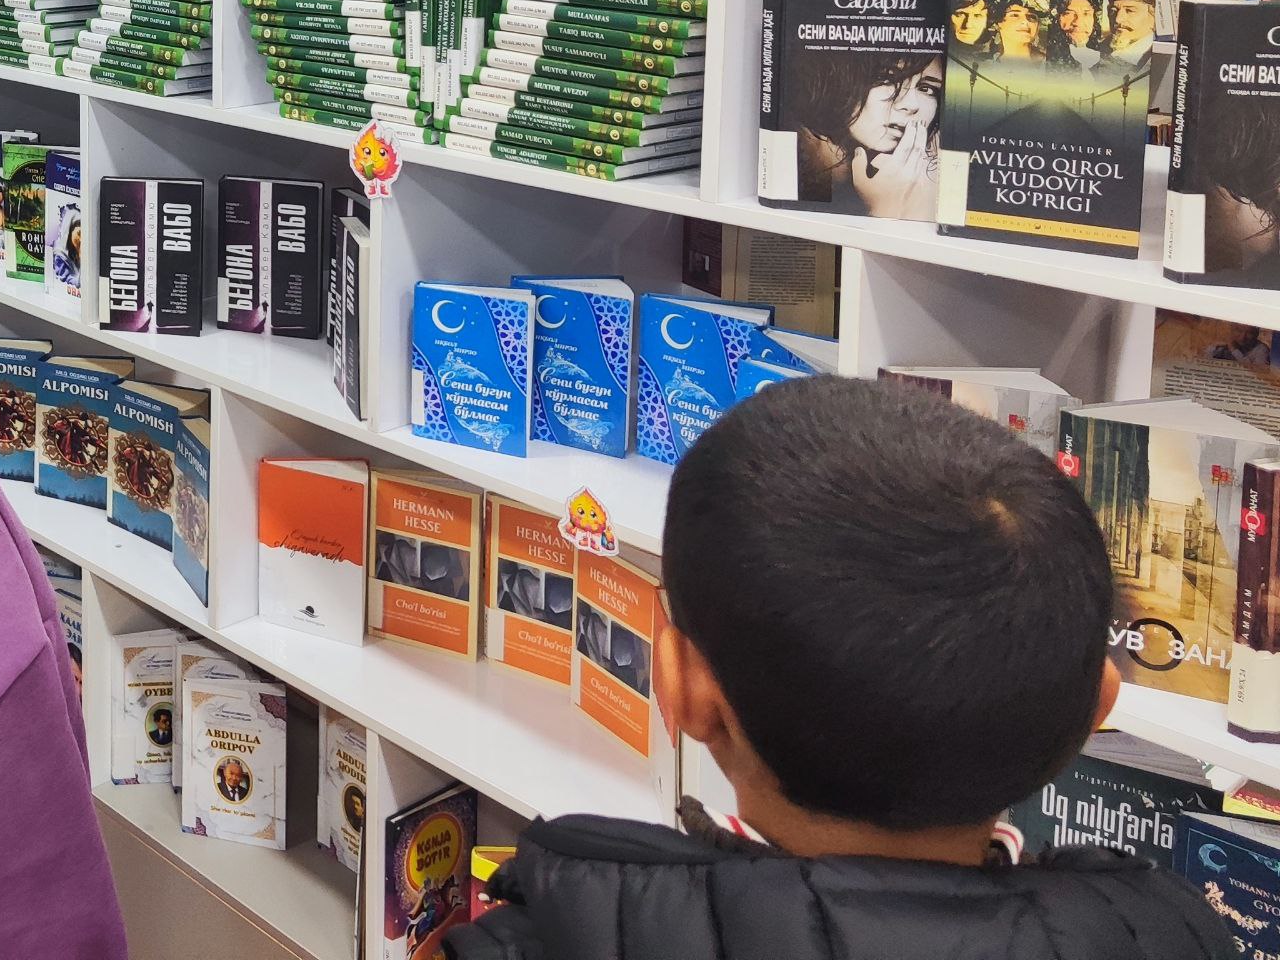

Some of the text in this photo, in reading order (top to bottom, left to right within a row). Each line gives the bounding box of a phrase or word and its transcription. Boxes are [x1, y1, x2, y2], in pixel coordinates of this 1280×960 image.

[797, 23, 826, 40] СЕНИ
[828, 25, 866, 43] ВАЪДА
[868, 26, 924, 45] ҚИЛГАНДИ
[1219, 63, 1255, 84] СЕНИ
[970, 150, 1124, 180] AVLIYO QIROL
[1172, 144, 1183, 169] СЕНИ
[989, 169, 1103, 196] LYUDOVIK
[162, 202, 192, 252] ВАБО
[277, 203, 307, 253] ВАБО
[109, 245, 139, 312] БЕГОНА
[225, 244, 254, 311] БЕГОНА
[113, 403, 174, 435] ALPOMISH
[393, 497, 455, 521] HERMANN
[404, 515, 442, 534] HESSE
[528, 544, 567, 565] HESSE
[589, 566, 640, 606] HERMANN
[598, 588, 629, 617] HESSE
[205, 728, 261, 744] ABDULLA
[210, 740, 256, 755] ORIPOV
